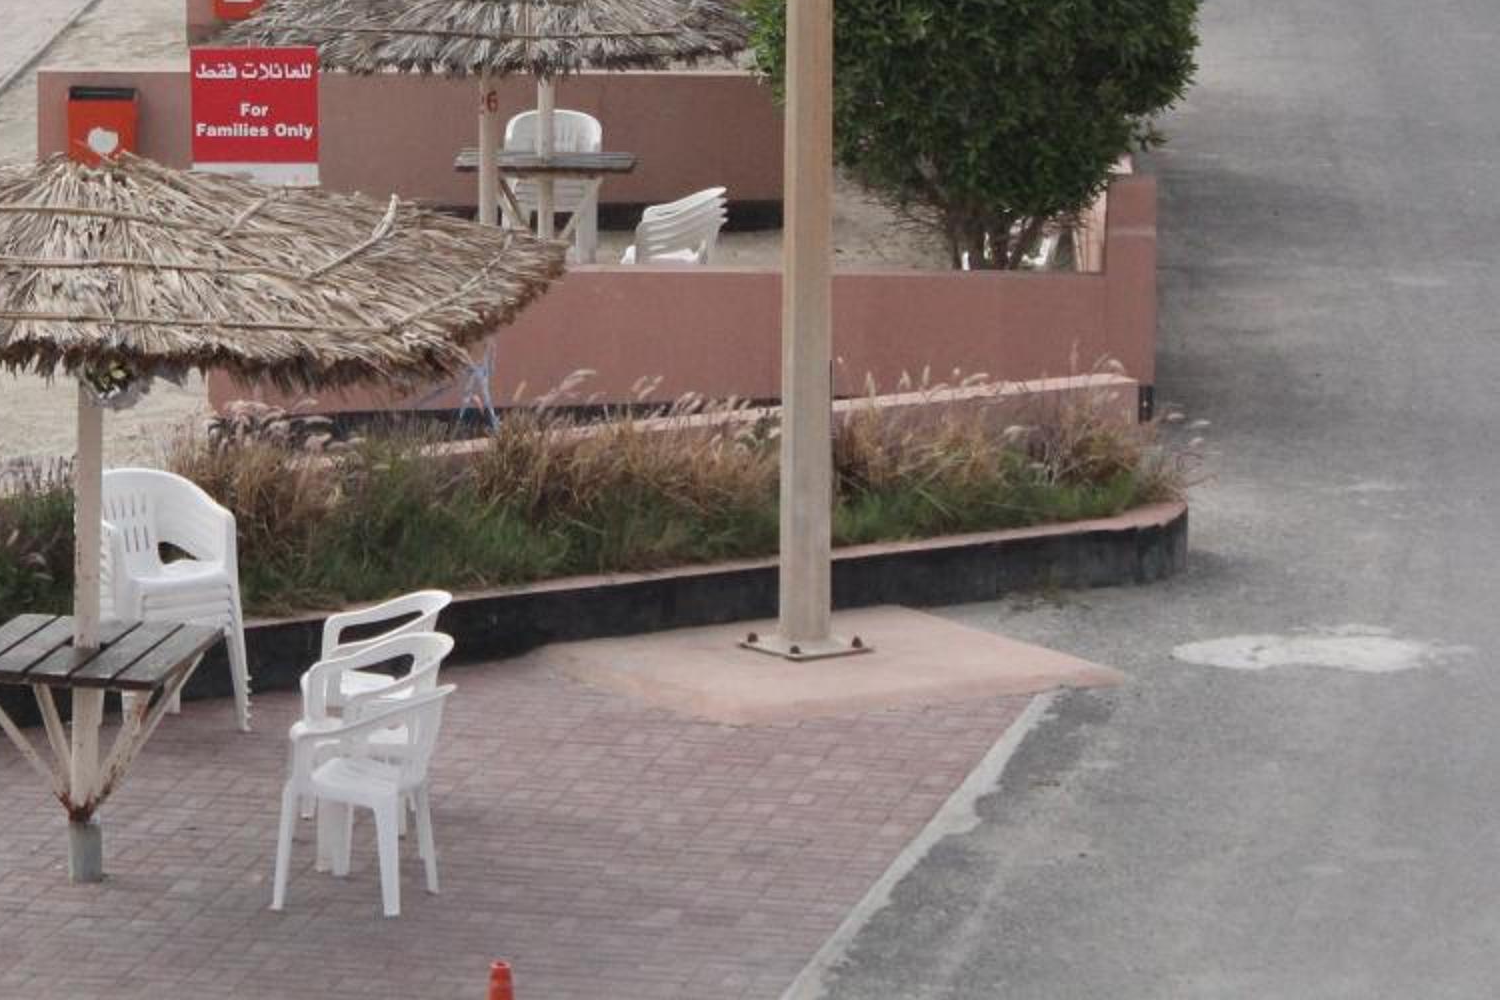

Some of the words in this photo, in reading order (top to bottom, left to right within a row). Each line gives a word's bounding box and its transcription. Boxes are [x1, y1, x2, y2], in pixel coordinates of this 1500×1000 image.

[195, 62, 237, 79] فقط
[242, 62, 313, 80] للعائلات
[240, 102, 269, 117] For
[195, 123, 269, 137] Families
[274, 123, 313, 140] Only
